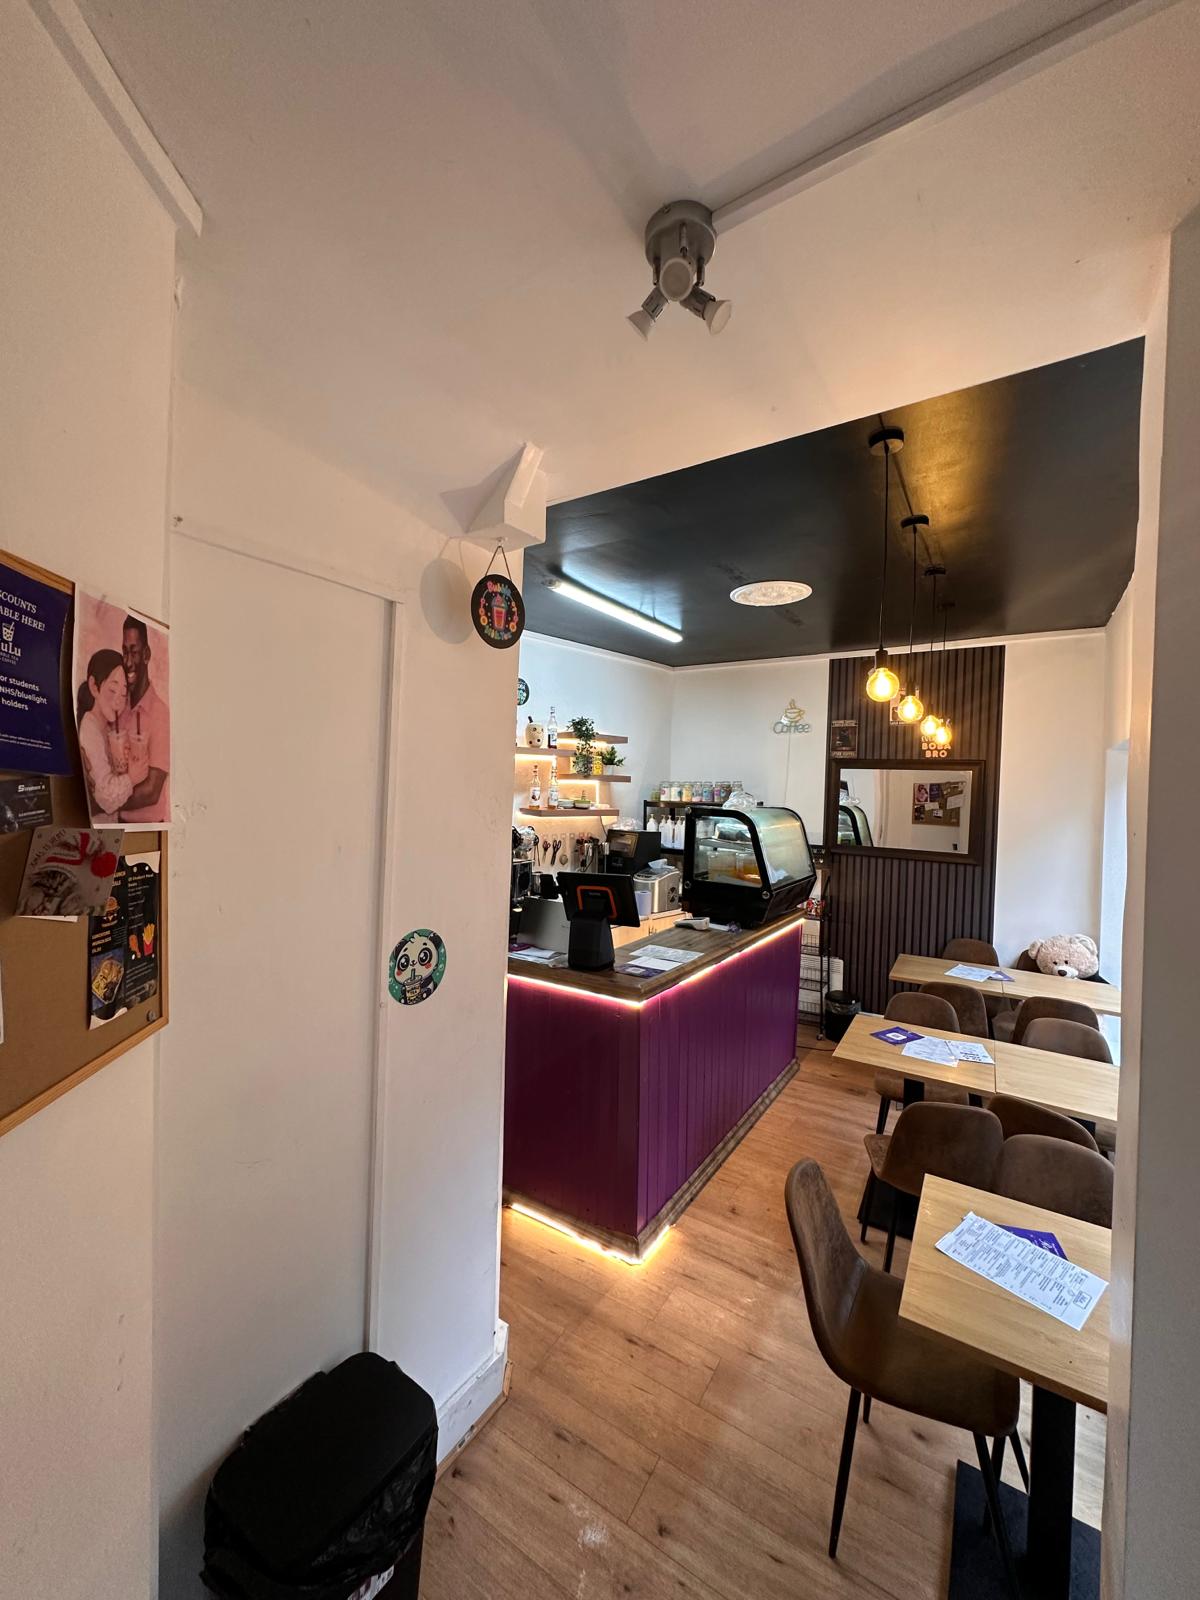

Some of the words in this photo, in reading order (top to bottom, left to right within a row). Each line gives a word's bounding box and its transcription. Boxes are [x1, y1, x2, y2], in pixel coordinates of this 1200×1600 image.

[21, 615, 46, 632] HERE!
[9, 678, 40, 692] students
[1, 697, 29, 711] holders
[773, 721, 810, 735] Coffee
[925, 750, 948, 758] BRO
